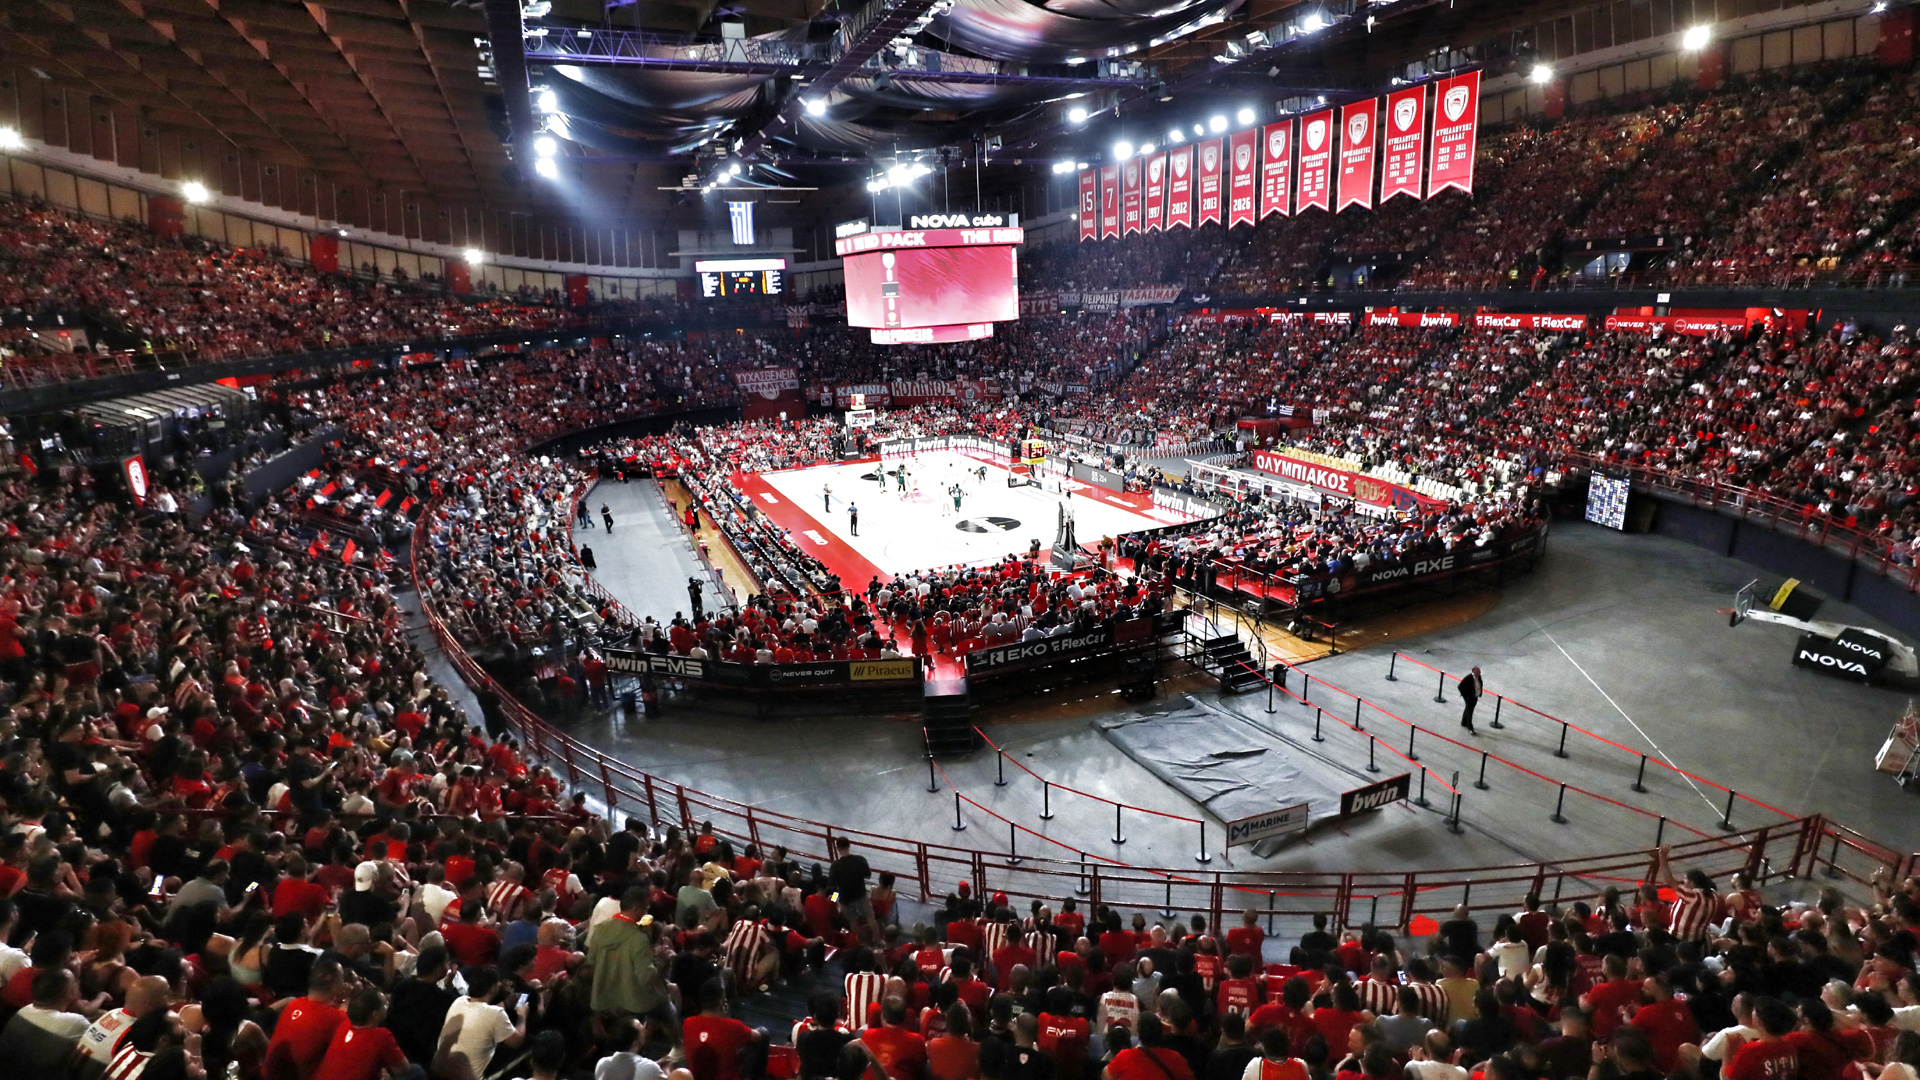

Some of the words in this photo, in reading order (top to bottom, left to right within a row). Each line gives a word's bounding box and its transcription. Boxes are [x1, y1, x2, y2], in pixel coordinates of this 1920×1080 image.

[1083, 191, 1093, 212] 15
[1107, 188, 1113, 209] 7
[1203, 197, 1217, 210] 2013
[1233, 196, 1250, 212] 2026
[1127, 210, 1138, 222] 2013
[1149, 206, 1160, 218] 1997
[1172, 202, 1187, 215] 2012
[911, 214, 970, 228] NOVA
[972, 214, 1002, 226] cube
[882, 232, 926, 247] PACK
[961, 230, 990, 243] THE
[1082, 292, 1118, 304] ΠΕΙΡΑΙΑΣ
[1314, 313, 1351, 324] FMS
[1420, 313, 1452, 327] bwin
[1484, 316, 1520, 326] FlexCar
[1542, 317, 1583, 328] FlexCar
[836, 385, 888, 396] KAMINIA
[881, 442, 912, 454] bwin
[914, 437, 945, 450] bwin
[948, 436, 978, 449] bwin
[978, 438, 994, 450] bwin
[995, 442, 1011, 458] bwin
[1031, 448, 1043, 458] 24
[1256, 454, 1350, 492] ΟΛΥΜΠΙΑΚΟΣ
[1154, 488, 1184, 512] bwin
[1186, 498, 1216, 518] bwin
[1372, 568, 1408, 581] NOVA
[1414, 556, 1454, 575] AXE
[1062, 634, 1106, 650] FlexCar
[1838, 639, 1881, 660] NOVA
[1008, 644, 1047, 660] EKO
[606, 652, 648, 672] bwin
[650, 657, 703, 676] FMS
[1800, 650, 1867, 675] NOVA
[868, 666, 911, 676] Piraeus
[1351, 784, 1398, 813] bwin
[1251, 814, 1290, 830] MARINE
[1046, 1026, 1076, 1038] FMS
